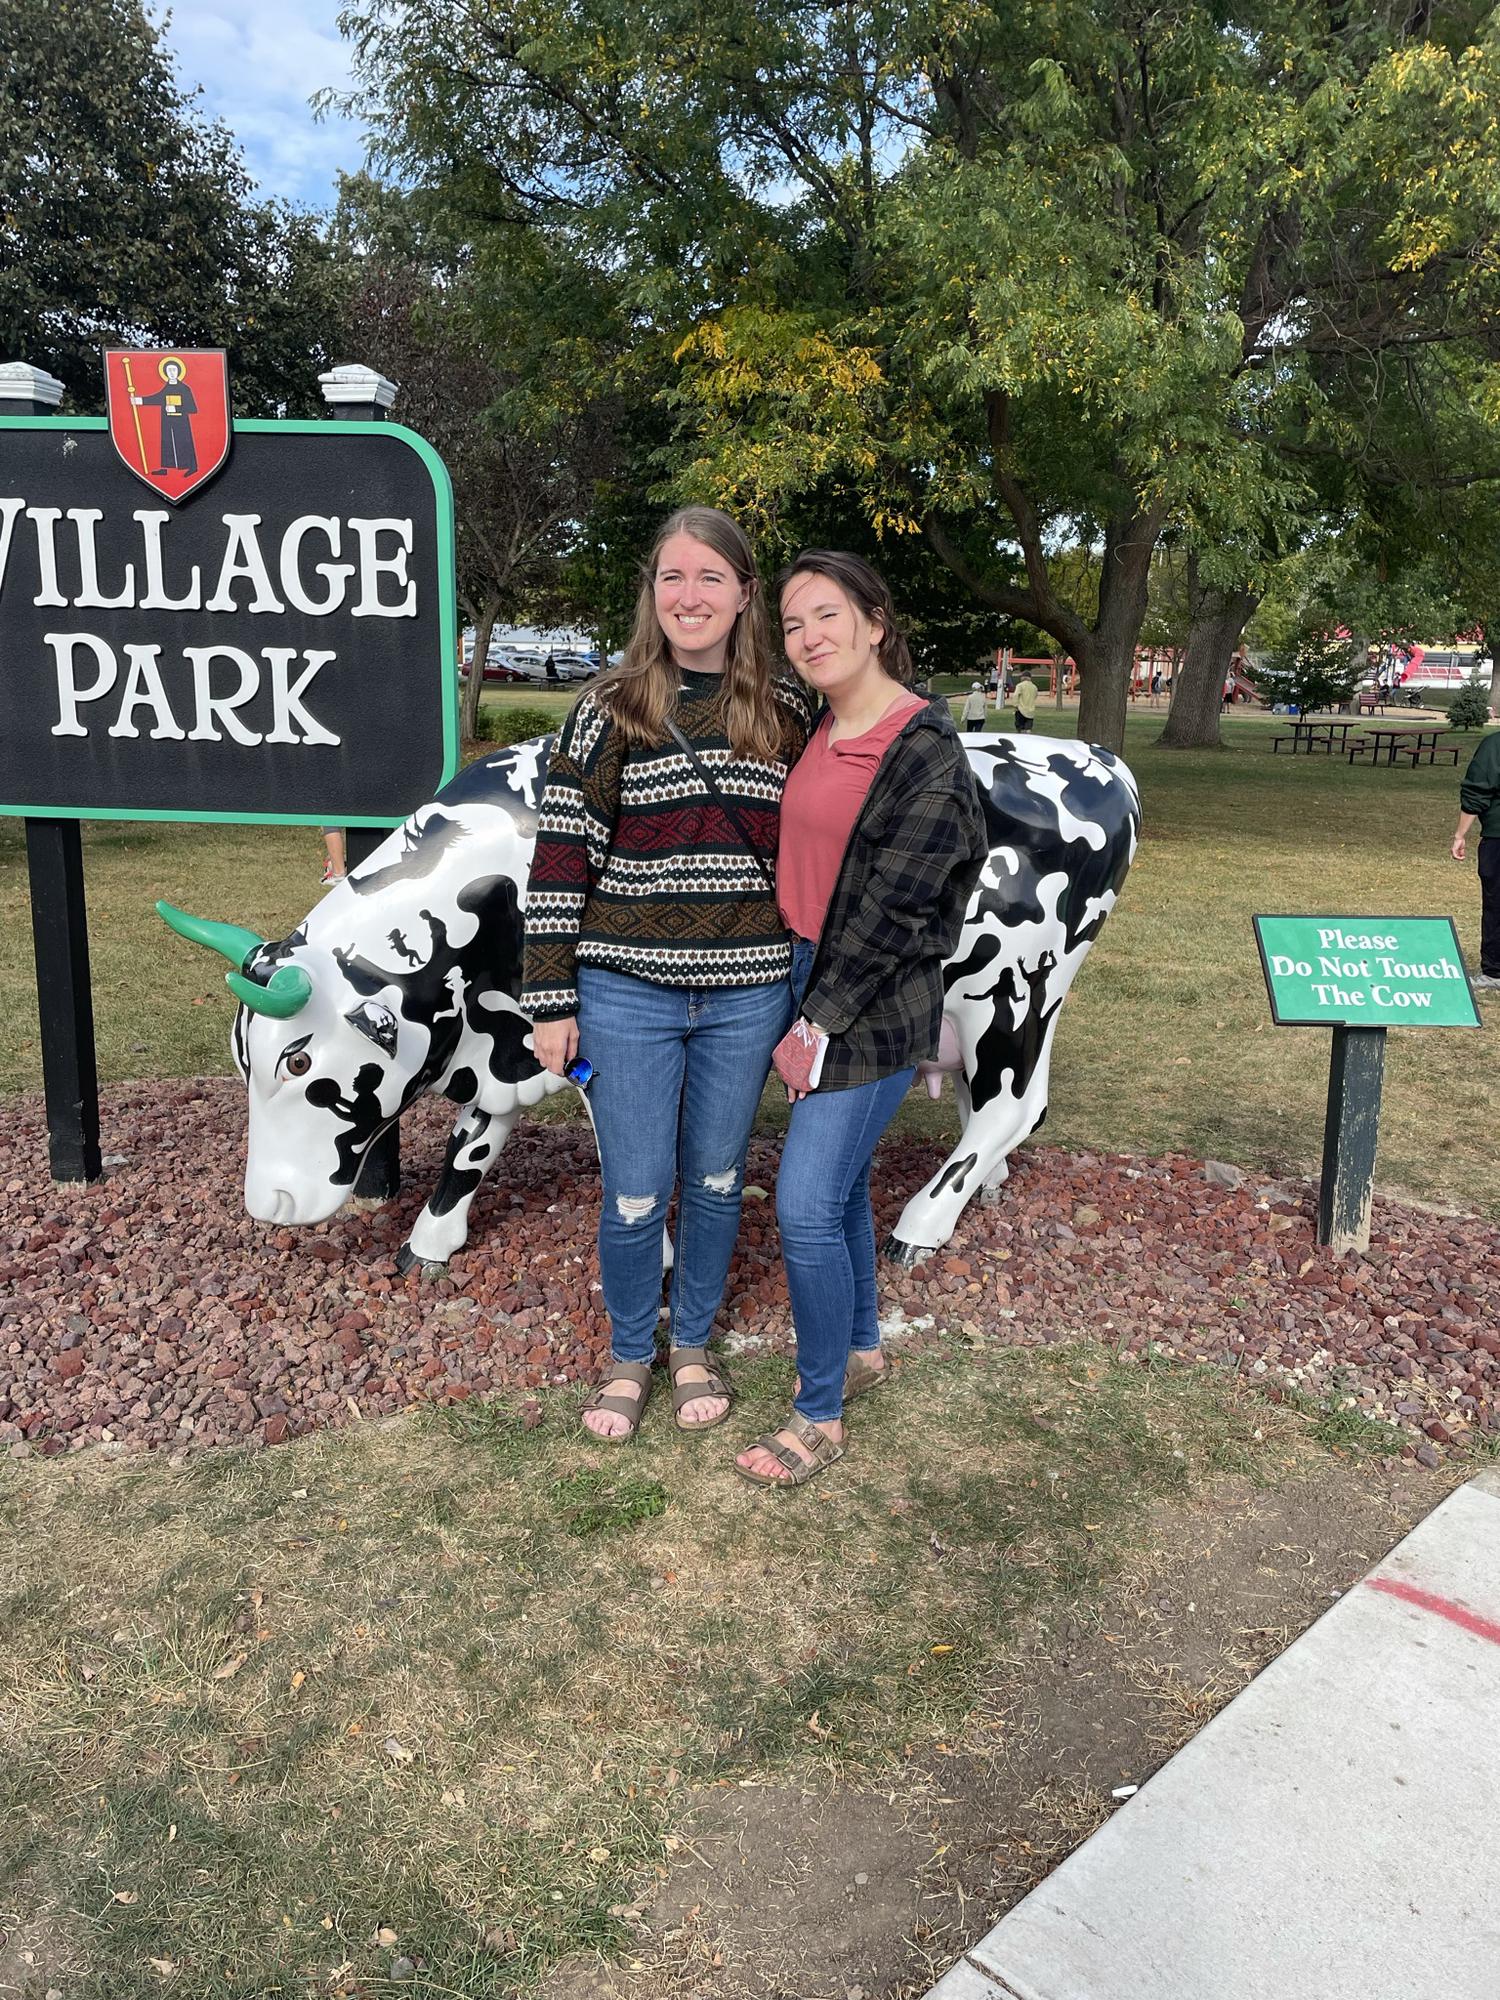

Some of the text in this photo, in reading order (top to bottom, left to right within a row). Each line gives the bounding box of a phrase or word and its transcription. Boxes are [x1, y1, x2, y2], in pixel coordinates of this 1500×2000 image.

[43, 632, 341, 747] PARK
[1317, 928, 1399, 951] Please
[1270, 955, 1462, 980] Do Not Touch
[1311, 983, 1433, 1008] The Cow
